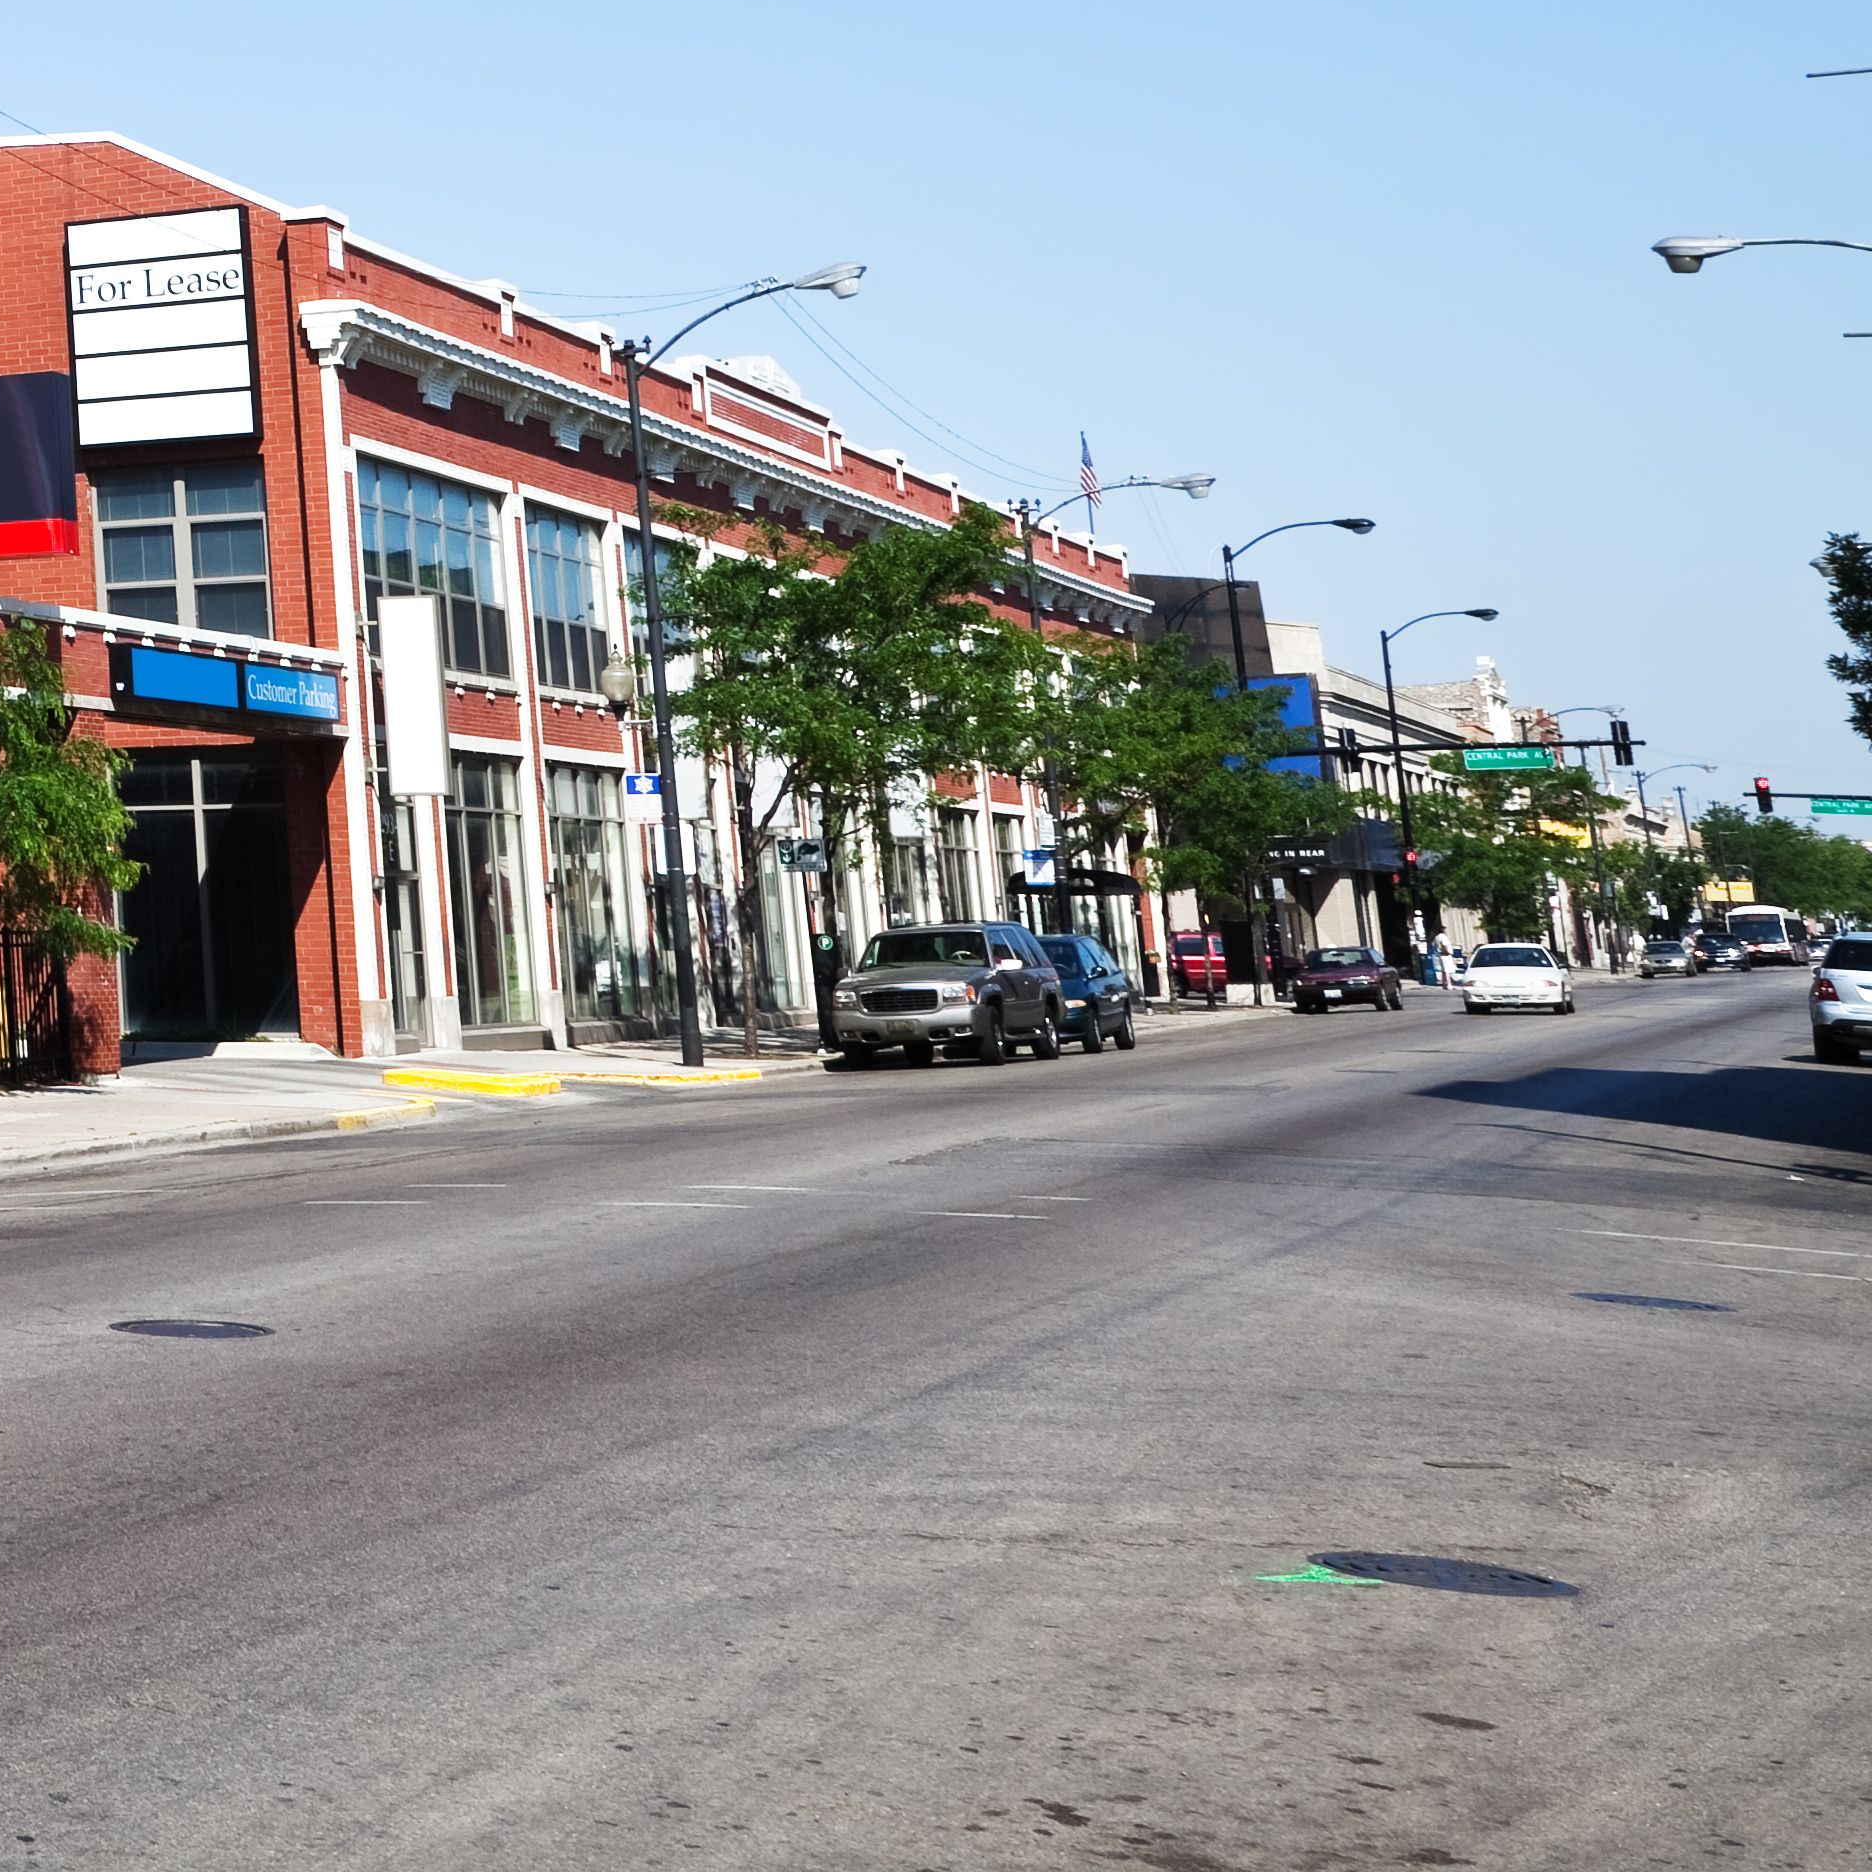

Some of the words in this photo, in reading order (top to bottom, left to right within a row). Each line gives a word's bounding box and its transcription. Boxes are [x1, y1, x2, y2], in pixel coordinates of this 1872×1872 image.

[76, 274, 132, 304] For
[143, 267, 240, 298] Lease
[247, 674, 297, 705] Customer
[298, 680, 336, 718] Parking
[1466, 751, 1503, 761] CENTRAL
[1506, 751, 1528, 760] PARK
